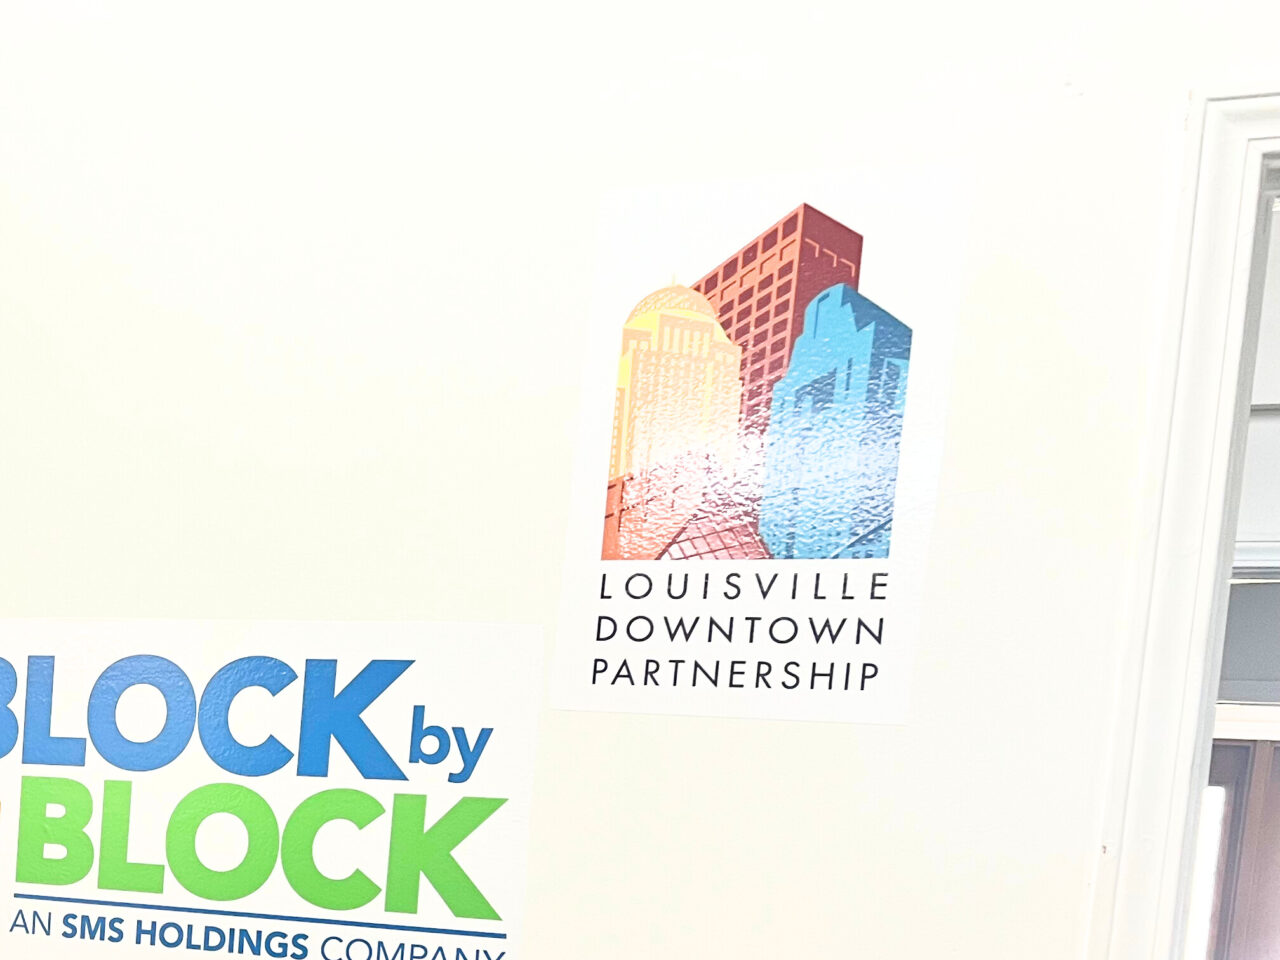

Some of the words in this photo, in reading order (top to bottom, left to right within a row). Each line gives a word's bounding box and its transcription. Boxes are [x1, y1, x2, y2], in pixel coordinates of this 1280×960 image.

[600, 572, 889, 600] LOUISVILLE
[596, 615, 884, 645] DOWNTOWN
[592, 658, 879, 691] PARTNERSHIP
[408, 704, 494, 783] by
[15, 775, 509, 921] BLOCK
[9, 909, 52, 937] AN
[61, 913, 124, 943] SMS
[135, 919, 309, 960] HOLDINGS
